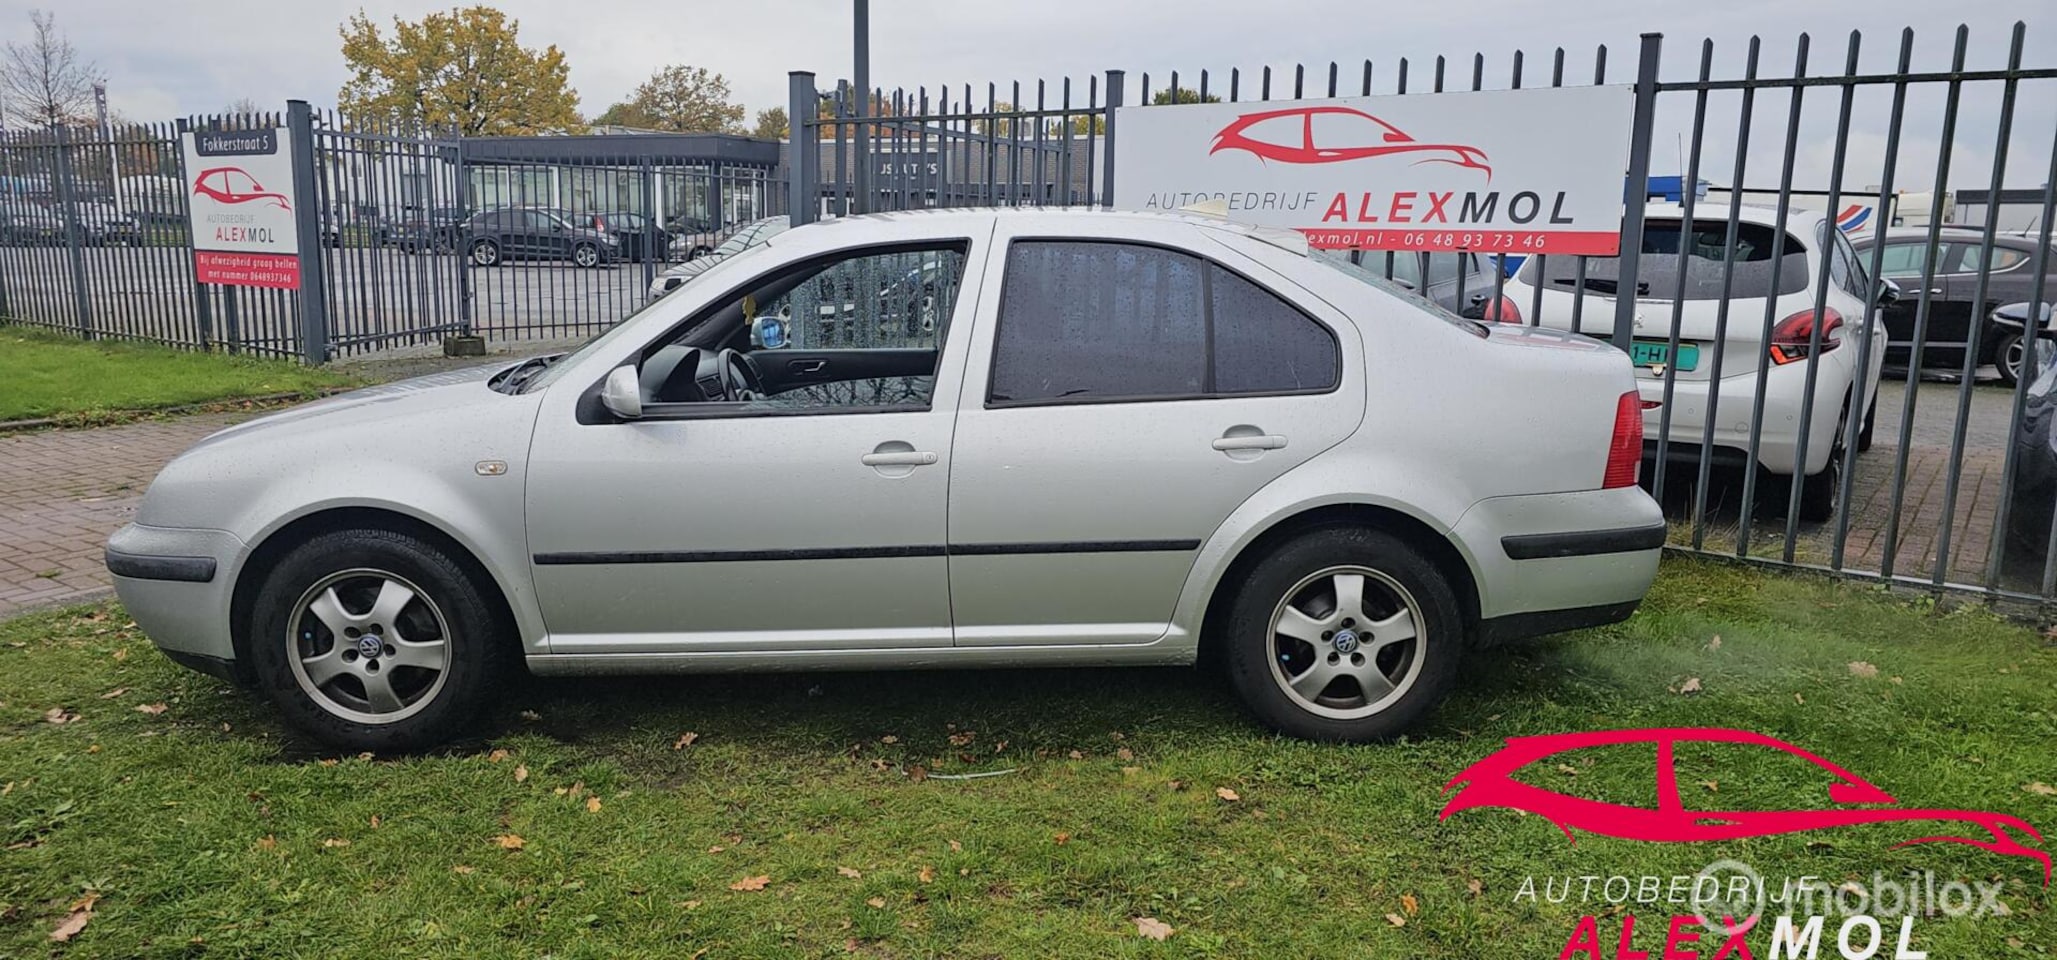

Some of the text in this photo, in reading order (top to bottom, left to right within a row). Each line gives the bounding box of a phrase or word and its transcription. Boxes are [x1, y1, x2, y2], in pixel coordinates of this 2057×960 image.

[202, 135, 269, 152] Fokkerstraat 5
[1321, 191, 1575, 224] ALEXMOL
[206, 213, 256, 225] AUTOBEDRIJF
[215, 227, 275, 243] ALEXMOL
[1404, 232, 1425, 245] 06
[1433, 233, 1454, 246] 48
[1462, 234, 1483, 247] 93
[1493, 234, 1514, 247] 73
[1522, 235, 1545, 248] 46
[200, 255, 298, 270] Bij afwezigheid graag bellen
[207, 270, 292, 283] met nummer 0648937346
